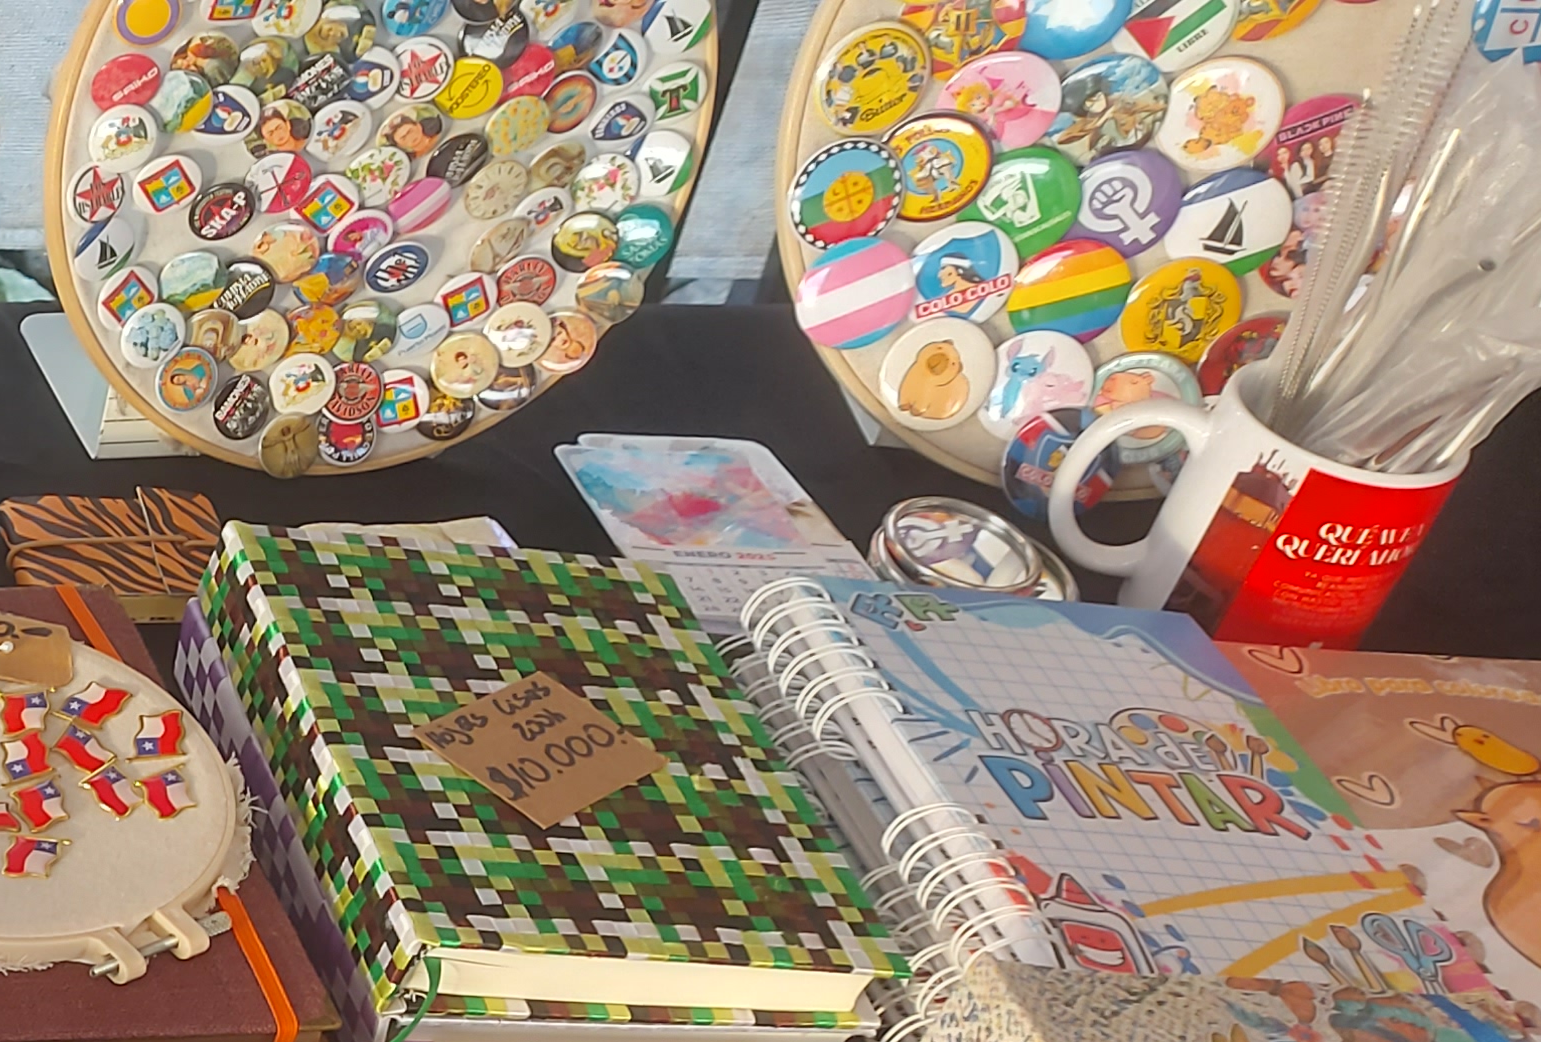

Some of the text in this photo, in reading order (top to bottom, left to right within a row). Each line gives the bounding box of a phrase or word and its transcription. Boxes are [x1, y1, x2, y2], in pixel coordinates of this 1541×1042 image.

[1175, 28, 1209, 53] LIBRE
[200, 190, 248, 239] SKA-P
[917, 276, 1011, 316] COLO COLO
[1275, 533, 1363, 566] QUERÍ
[1318, 522, 1381, 546] QUÉ
[673, 550, 732, 559] ENERO
[965, 708, 1146, 768] HORA
